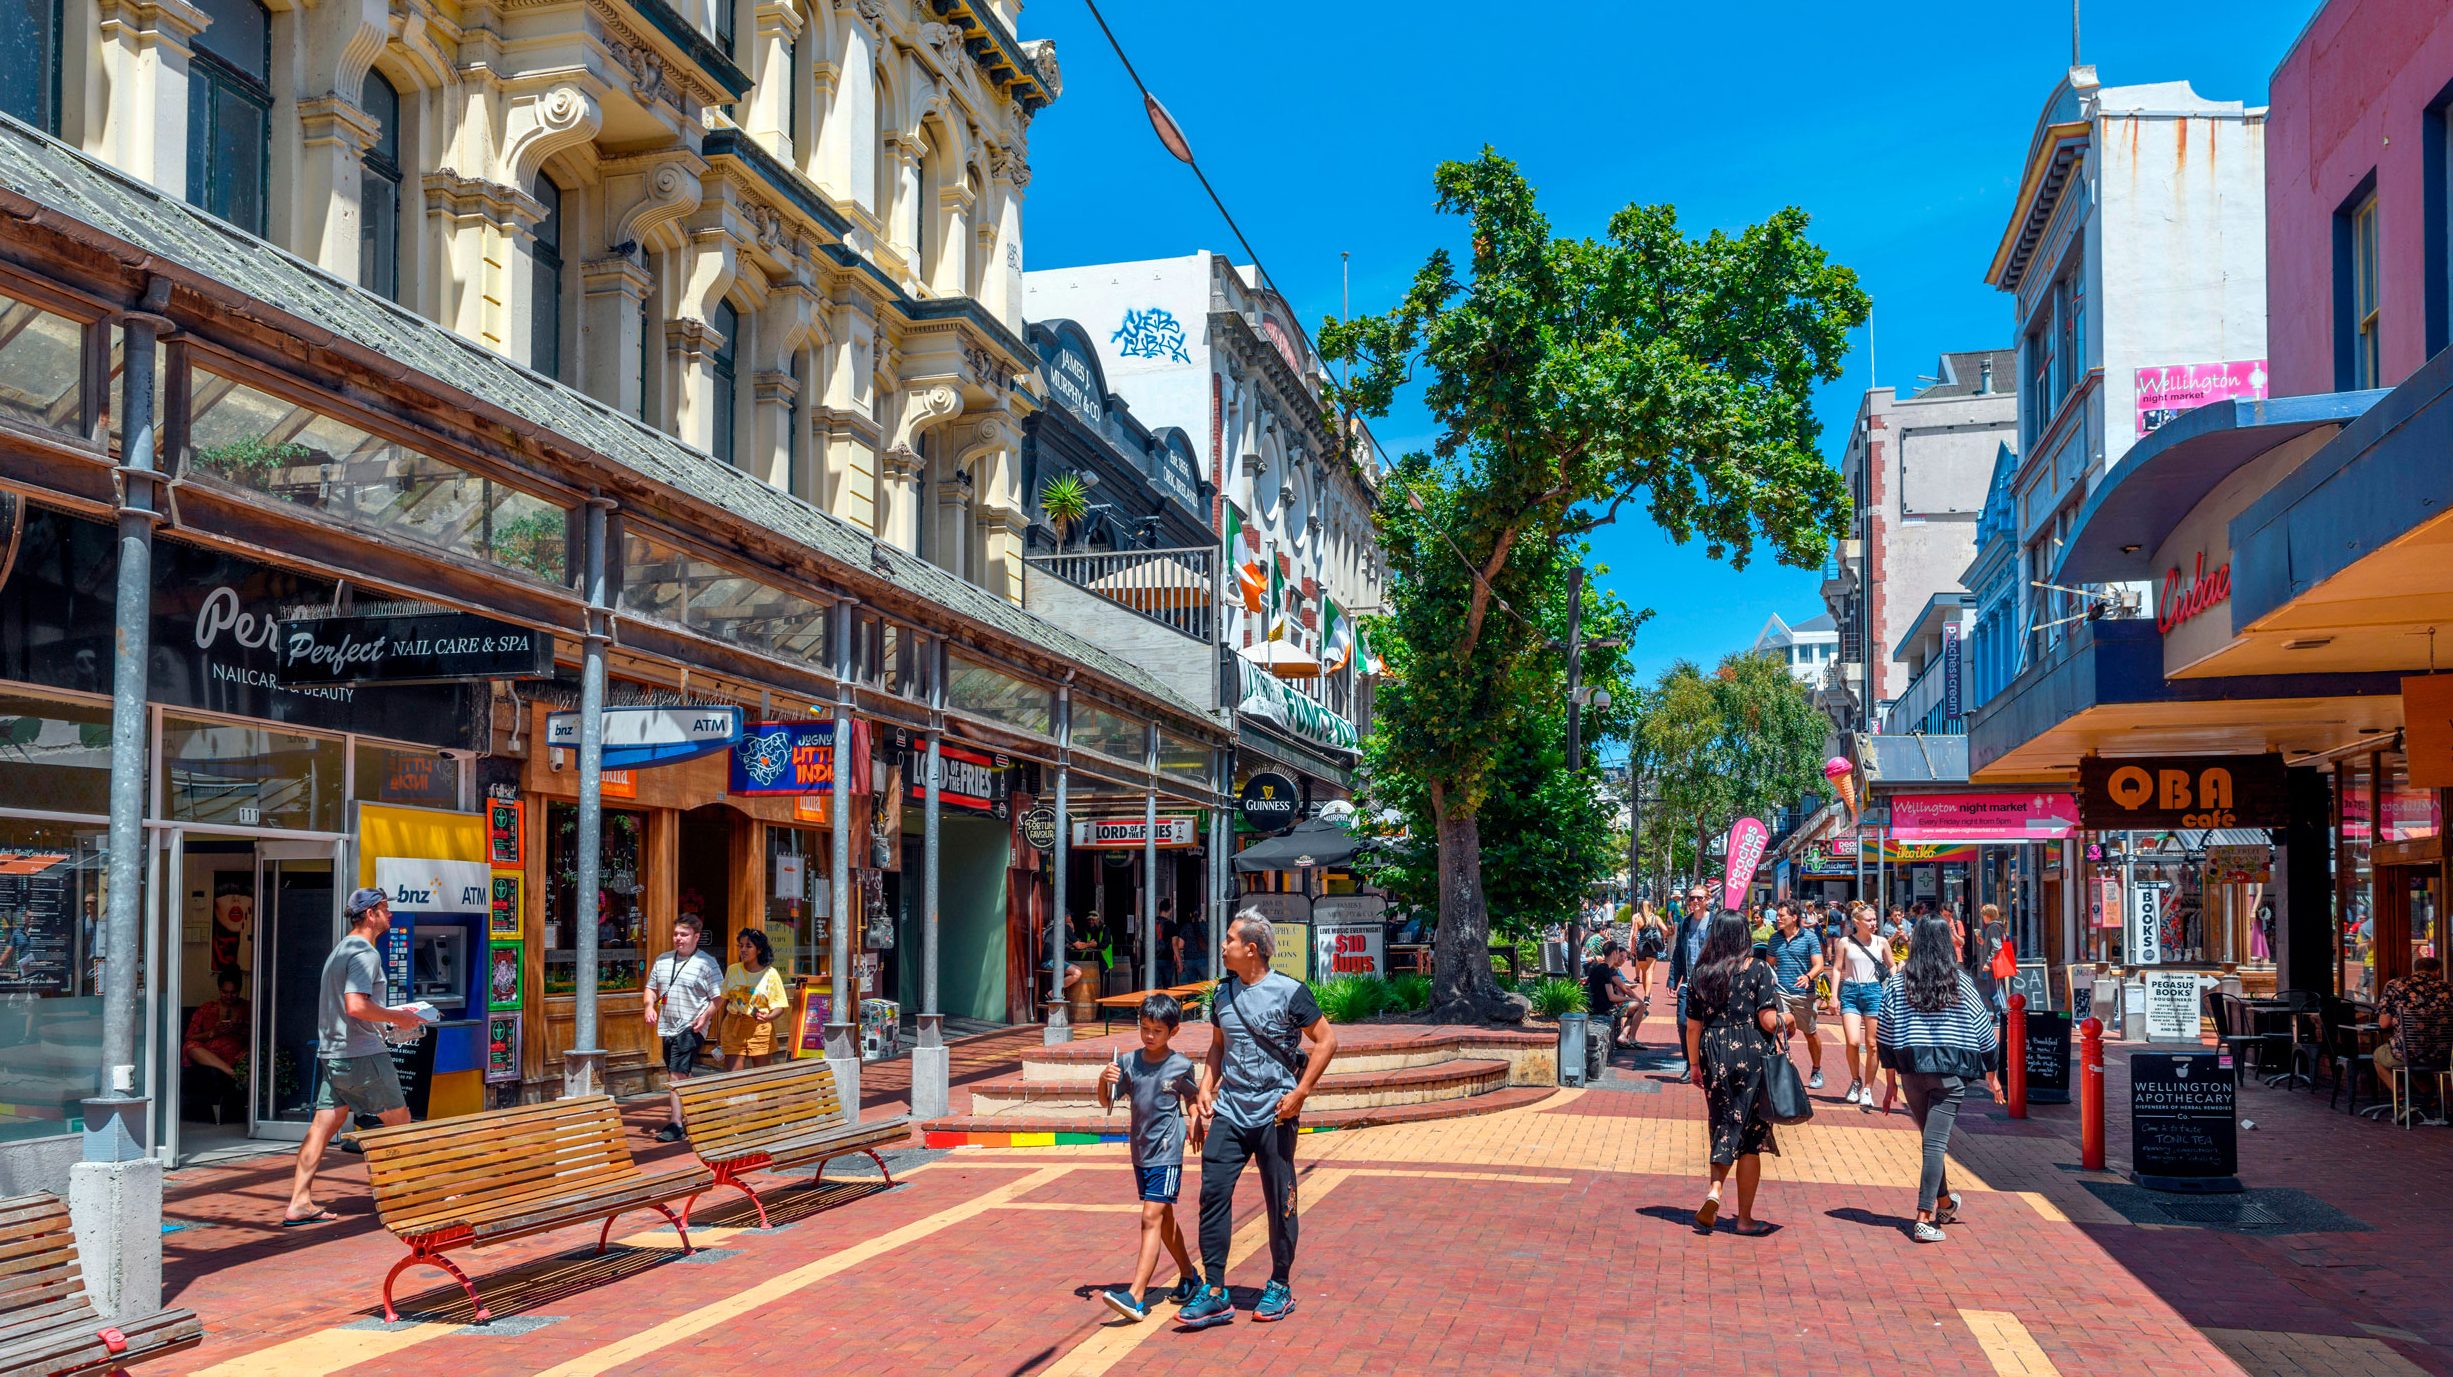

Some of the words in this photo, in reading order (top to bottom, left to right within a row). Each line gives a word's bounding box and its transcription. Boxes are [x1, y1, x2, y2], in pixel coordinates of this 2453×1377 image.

[1061, 348, 1085, 383] JAMES
[1051, 365, 1083, 406] MURPHY
[1083, 395, 1089, 415] &
[1089, 403, 1100, 422] CO
[2140, 373, 2241, 394] Wellington
[2143, 394, 2167, 404] night
[2170, 391, 2204, 401] market
[287, 633, 385, 676] Perfect
[390, 640, 432, 657] NAIL
[434, 637, 480, 655] CARE
[482, 638, 494, 654] &
[496, 635, 530, 652] SPA
[213, 664, 284, 691] NAILCAR
[1948, 680, 1958, 715] cream
[555, 723, 574, 736] bnz
[693, 718, 726, 733] ATM
[795, 763, 834, 785] INDI
[913, 750, 949, 789] LOD
[950, 760, 960, 777] OF
[949, 775, 960, 792] THE
[960, 761, 992, 799] FRIES
[2107, 764, 2233, 811] QBA
[240, 807, 259, 823] 111
[1246, 798, 1290, 812] GUINNESS
[1893, 800, 1957, 816] Wellington
[1959, 803, 1987, 814] night
[1989, 802, 2027, 813] market
[1918, 818, 1938, 827] Every
[1940, 818, 1960, 826] Friday
[1961, 818, 1979, 827] night
[2182, 808, 2236, 828] café
[1096, 825, 1128, 840] LORD
[1129, 825, 1138, 833] OF
[1140, 824, 1172, 839] FIES
[1741, 834, 1767, 881] cream
[397, 884, 431, 904] bnz
[461, 886, 487, 906] ATM
[2141, 892, 2153, 947] BOOKS
[1350, 926, 1382, 934] EVERYNIGHT
[1335, 934, 1366, 954] $10
[1331, 953, 1375, 974] Jugs
[2151, 981, 2194, 989] PEGASUS
[2156, 988, 2190, 996] BOOKS
[2135, 1082, 2232, 1092] WELLINGTON
[2135, 1093, 2232, 1103] APOTHECARY
[2191, 1135, 2213, 1145] TEA
